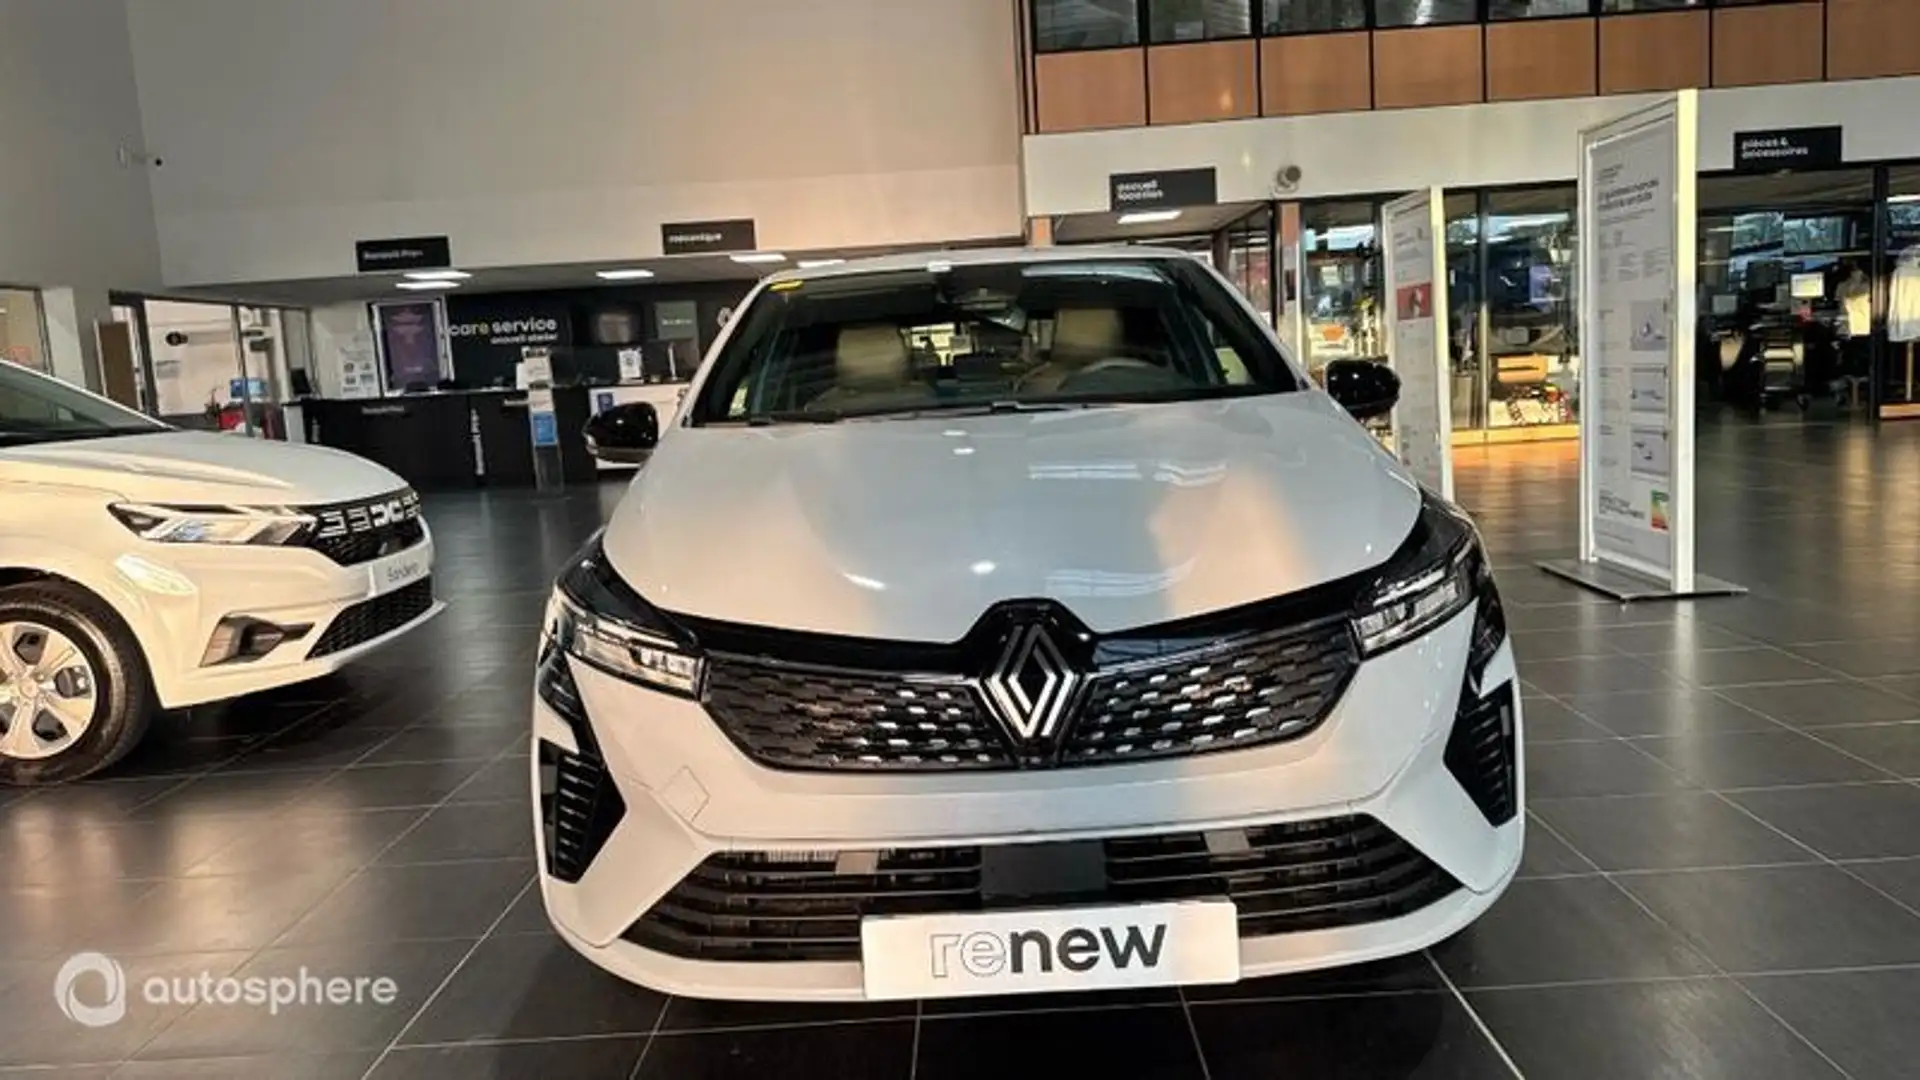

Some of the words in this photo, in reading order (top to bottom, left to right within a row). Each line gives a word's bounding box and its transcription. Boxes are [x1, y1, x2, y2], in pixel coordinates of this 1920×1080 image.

[449, 322, 489, 336] care
[491, 316, 558, 334] service
[929, 923, 1167, 979] renew
